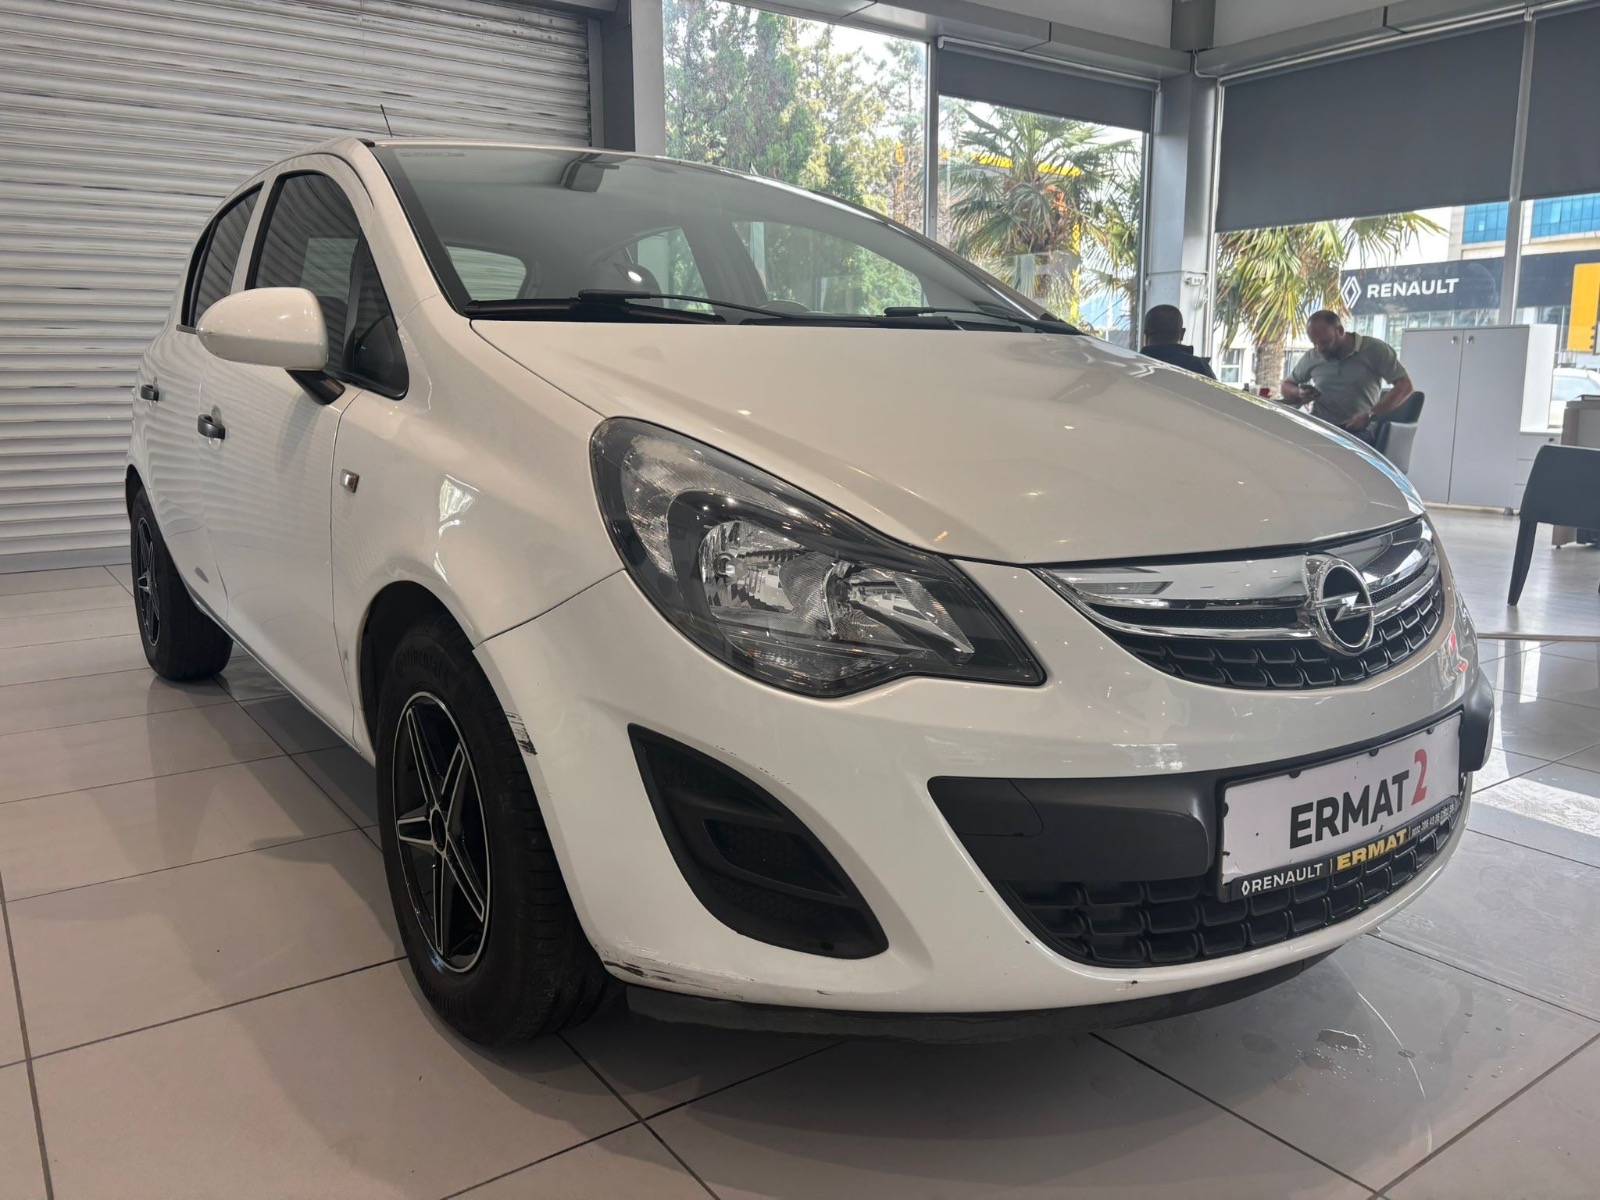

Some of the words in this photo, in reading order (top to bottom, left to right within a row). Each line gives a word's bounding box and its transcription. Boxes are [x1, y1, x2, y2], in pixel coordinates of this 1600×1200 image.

[1367, 278, 1459, 298] RENAULT
[1251, 863, 1323, 893] RENAULT
[1337, 828, 1407, 871] ERMAT
